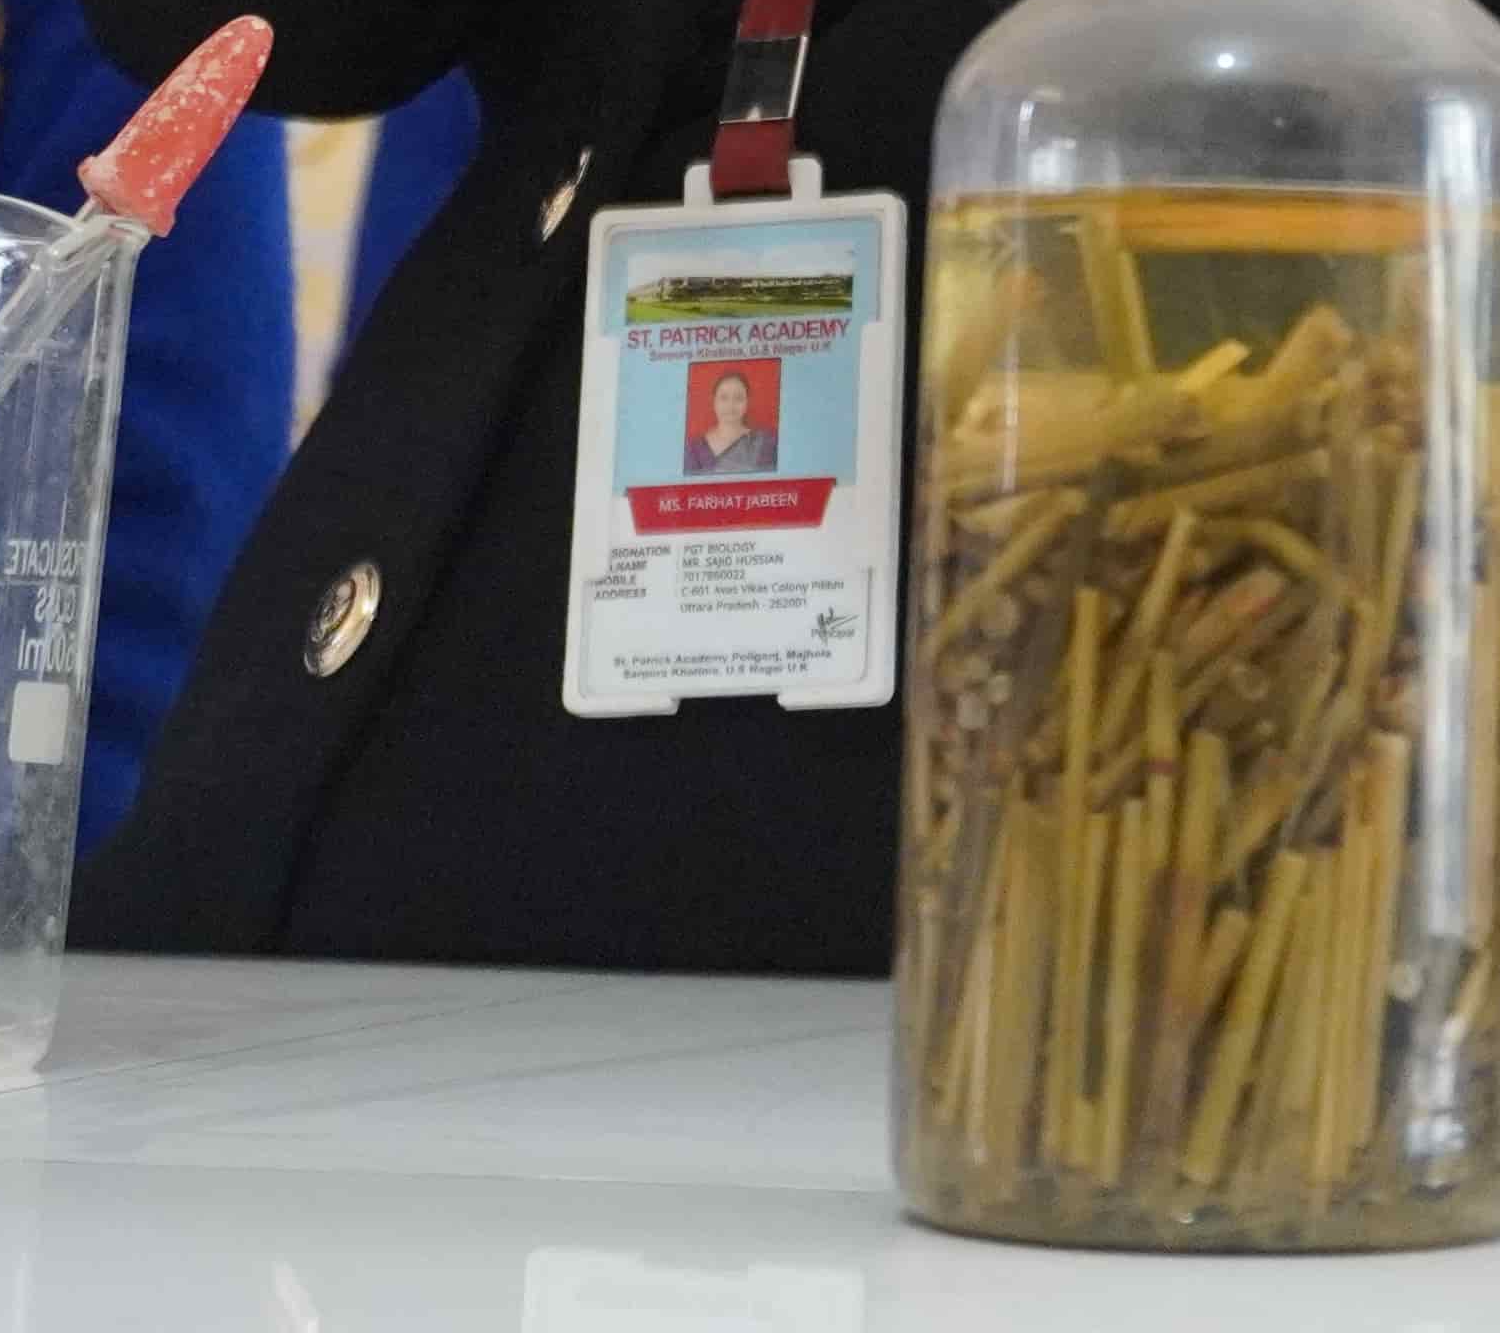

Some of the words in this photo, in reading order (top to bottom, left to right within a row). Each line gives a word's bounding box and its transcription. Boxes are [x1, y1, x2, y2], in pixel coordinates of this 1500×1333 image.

[659, 324, 741, 347] PATRICK
[749, 318, 850, 343] ACADEMY
[688, 496, 741, 511] FARHAT
[746, 493, 798, 510] JABEEN
